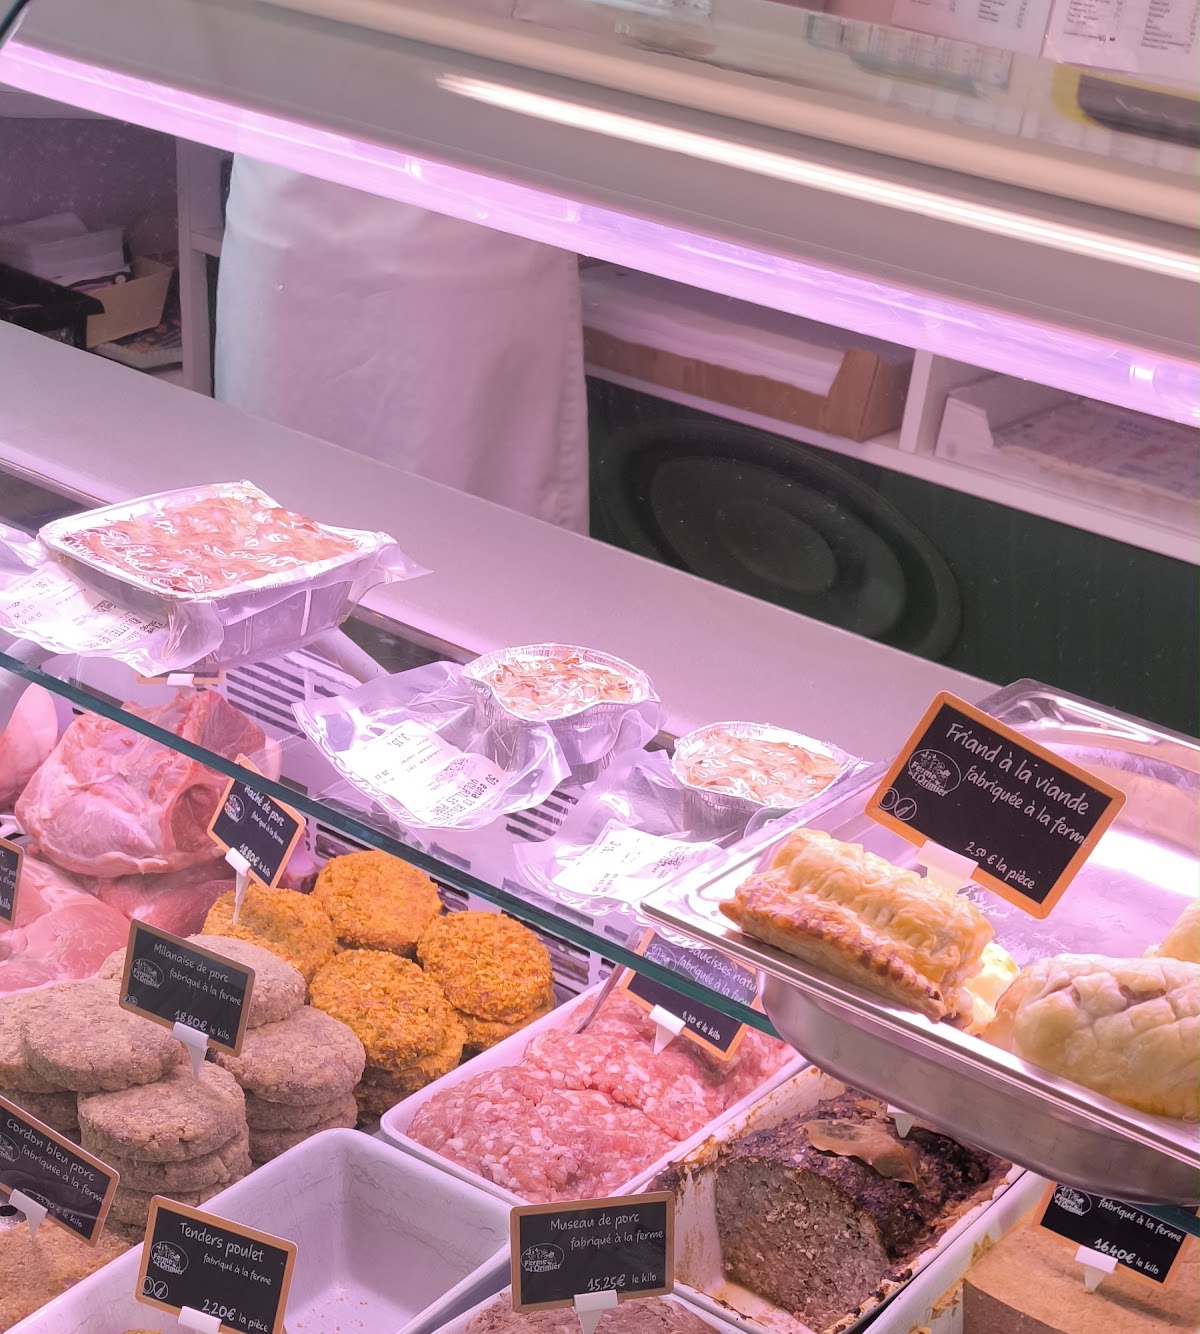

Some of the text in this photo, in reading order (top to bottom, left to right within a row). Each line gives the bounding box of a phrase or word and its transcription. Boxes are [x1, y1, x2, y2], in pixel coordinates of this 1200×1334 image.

[911, 761, 937, 780] Ferme
[946, 723, 1090, 815] Friand à la viande
[244, 785, 284, 826] Haché de porc
[963, 765, 1090, 848] fabriquée à la ferme
[965, 841, 1036, 890] 2.50 € la pièce
[154, 943, 229, 983] Milanaise de porc
[677, 955, 714, 981] fabriquée
[714, 980, 720, 991] à
[722, 983, 730, 996] la
[169, 968, 241, 1005] fabriqué à la ferme
[210, 1024, 215, 1035] le
[217, 1027, 230, 1040] kilo
[701, 1023, 708, 1033] le
[708, 1027, 720, 1040] kilo
[6, 1118, 95, 1182] Cordon bleu porc
[21, 1144, 60, 1176] fabriquée
[62, 1172, 69, 1183] à
[71, 1176, 79, 1189] la
[63, 1210, 68, 1218] le
[70, 1215, 82, 1227] kilo
[550, 1212, 640, 1231] Museau de porc
[1098, 1197, 1182, 1243] fabriqué à la ferme
[180, 1222, 264, 1263] Tenders poulet
[570, 1230, 664, 1250] fabriqué à la ferme
[203, 1253, 272, 1286] fabriqué à la ferme
[587, 1272, 657, 1291] 15.25€ le kilo
[1135, 1257, 1143, 1266] le
[1145, 1262, 1159, 1274] kilo
[238, 1313, 246, 1325] la
[248, 1319, 269, 1333] pièce
